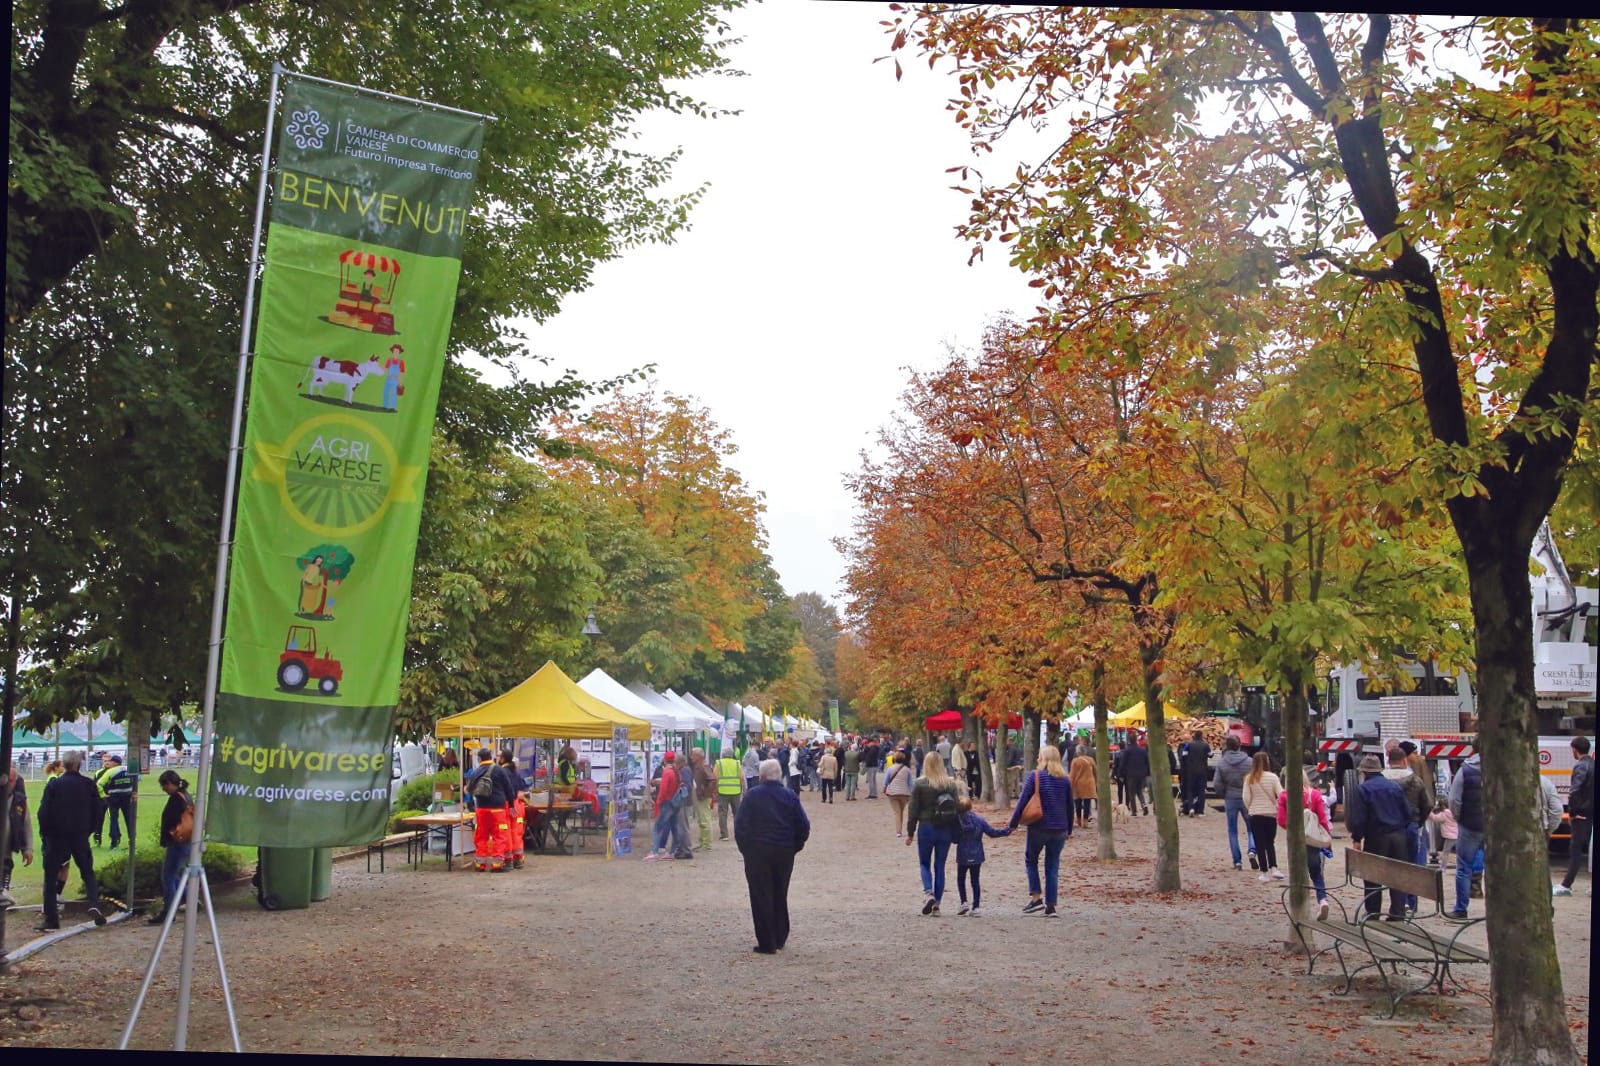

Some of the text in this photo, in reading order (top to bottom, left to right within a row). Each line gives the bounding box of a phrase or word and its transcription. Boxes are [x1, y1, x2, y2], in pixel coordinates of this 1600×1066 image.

[346, 134, 389, 152] VARESE
[347, 124, 479, 160] CAMERA DI COMMERCIO
[344, 146, 473, 180] Futuro Impresa Territorio
[280, 172, 467, 236] BENVENUTI
[310, 435, 370, 461] AGRI
[295, 451, 383, 482] VARESE
[220, 736, 386, 774] #agrivarese
[216, 781, 387, 803] www.agrivarese.com
